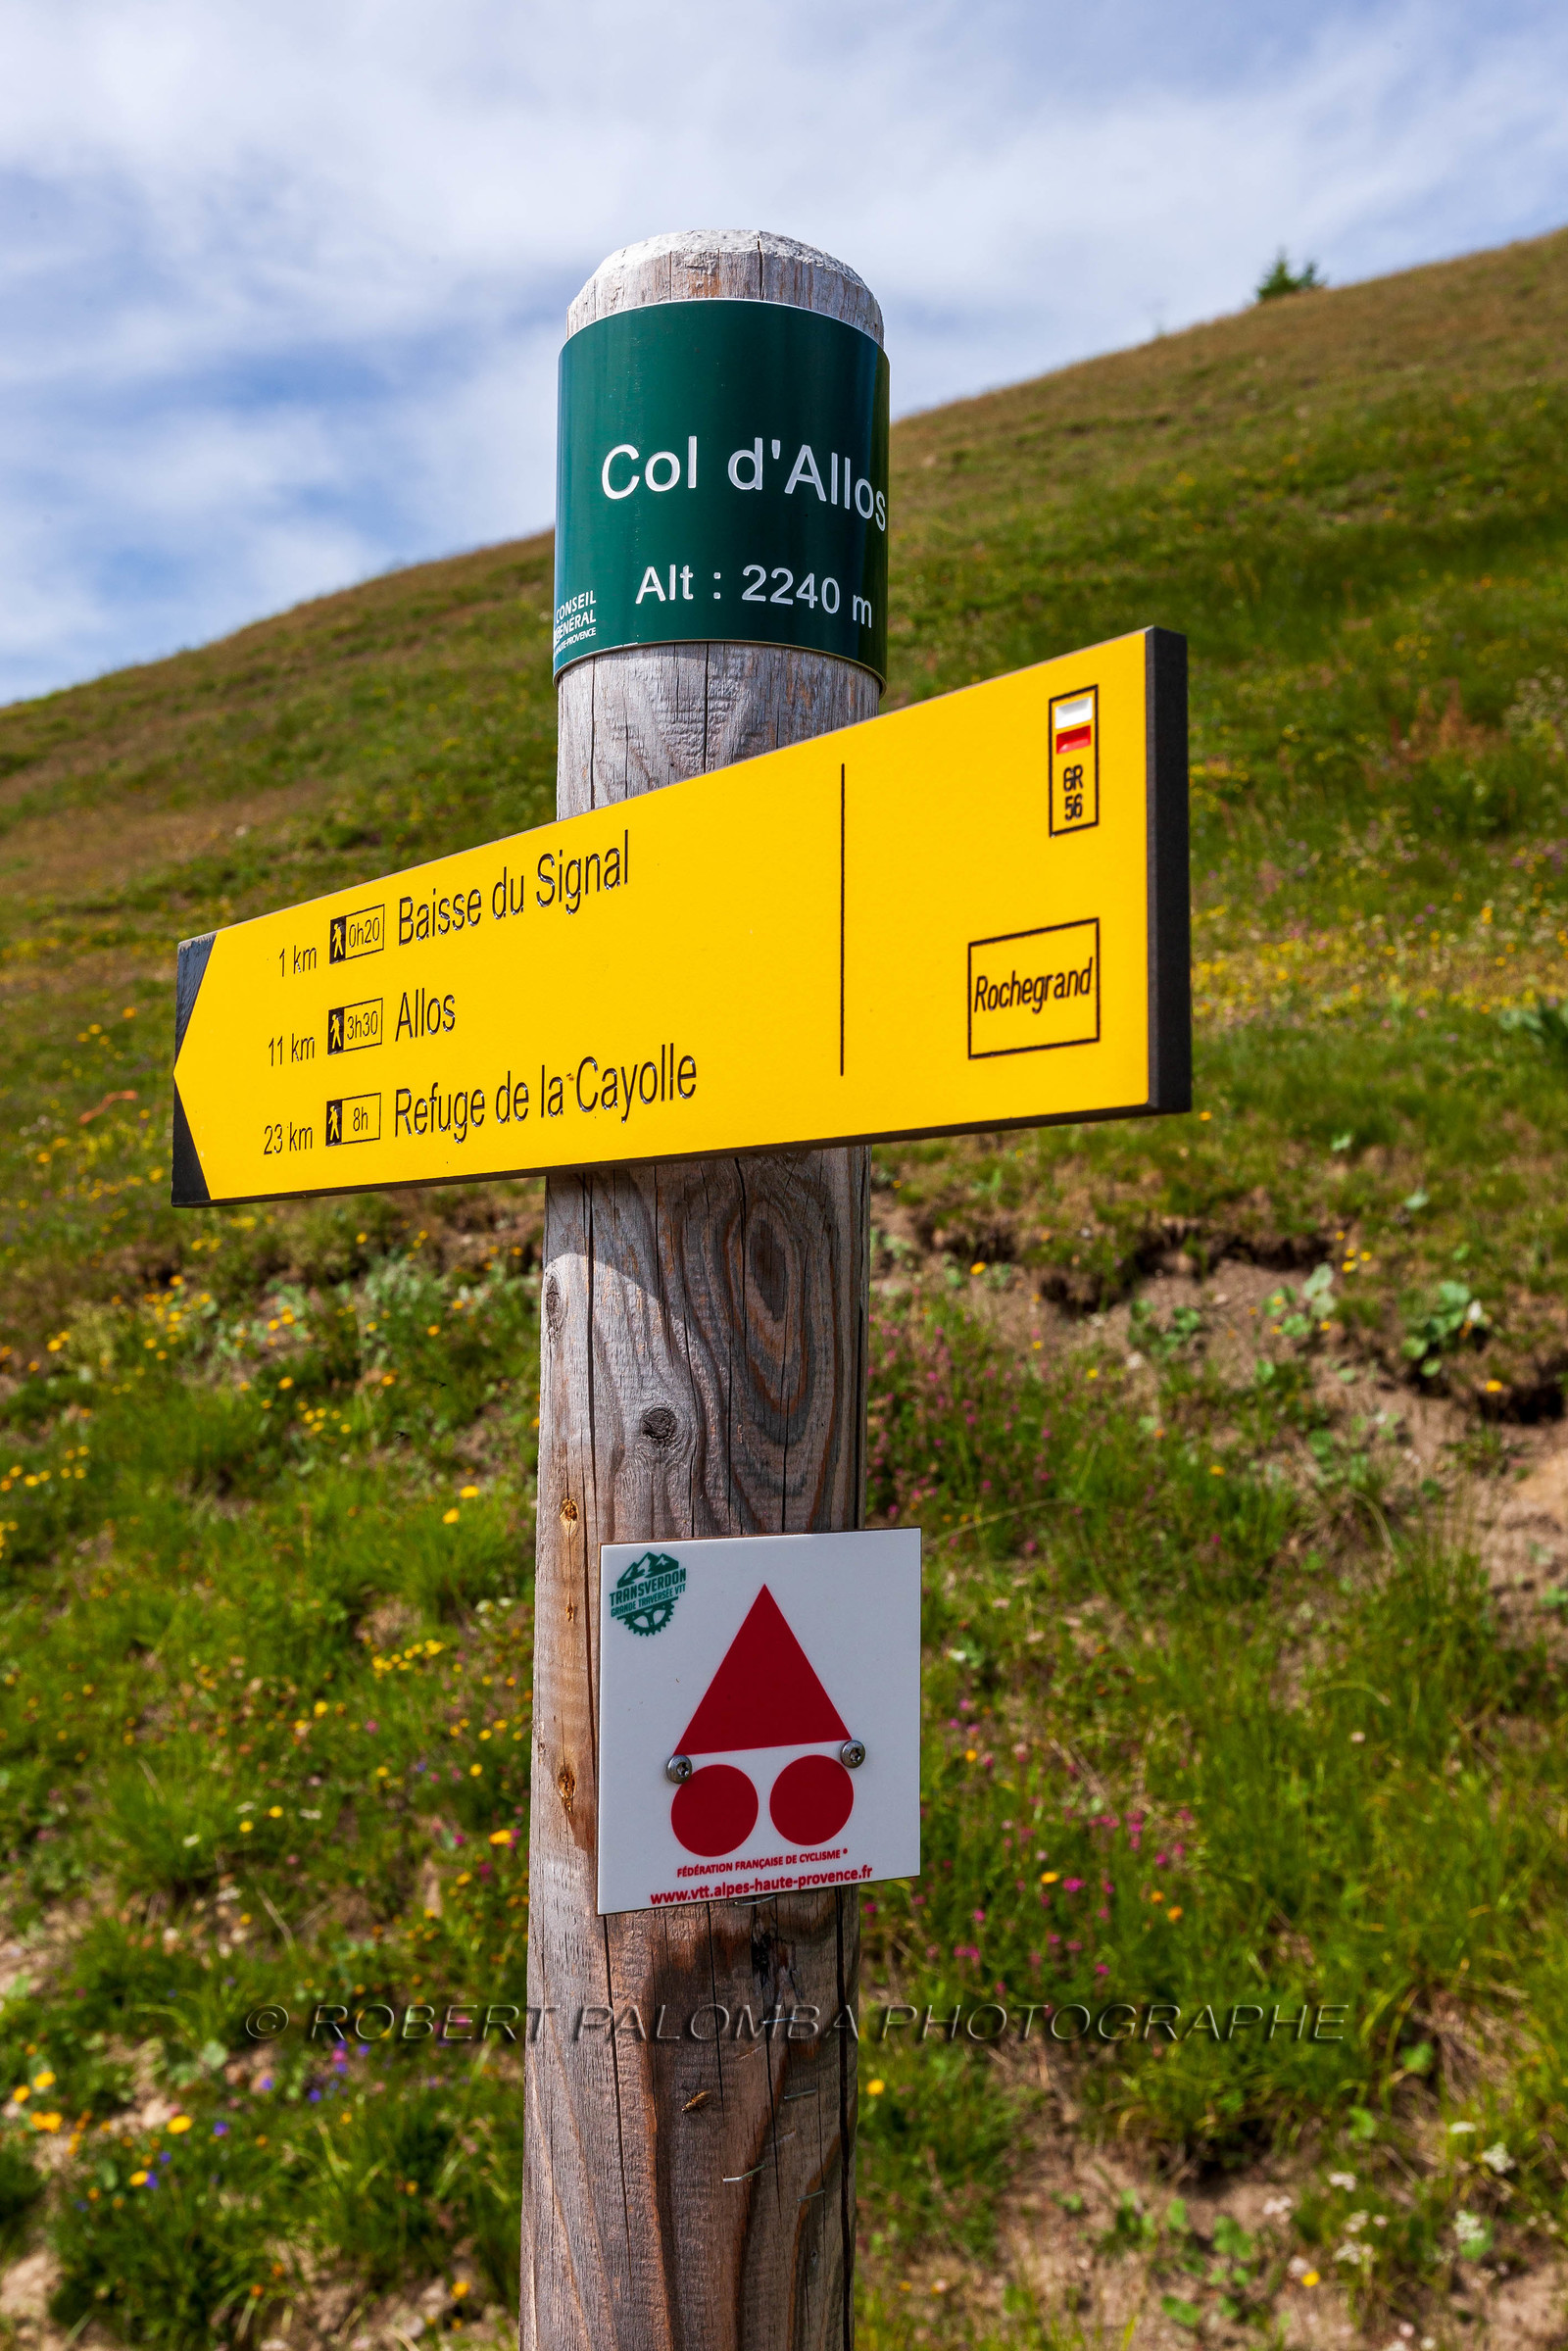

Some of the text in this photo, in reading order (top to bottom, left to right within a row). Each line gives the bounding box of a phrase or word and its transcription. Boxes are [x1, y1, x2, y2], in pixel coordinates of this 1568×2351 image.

[601, 435, 886, 531] Col d'Allos
[556, 590, 597, 624] CONSEIL
[635, 564, 694, 605] Alt
[742, 564, 840, 614] 2240
[852, 594, 872, 628] m
[1063, 764, 1084, 793] GR
[1064, 793, 1083, 821] 56
[278, 829, 628, 978] 1 km 0h20 Baisse du Signal
[974, 955, 1093, 1014] Rochegrand
[269, 987, 456, 1067] 11 km 3h30 Allos
[264, 1042, 698, 1155] 23 km 8h Refuge de la Cayolle
[610, 1568, 686, 1606] TRANSVERDON
[611, 1583, 686, 1617] GRANDE TRAVERSÉE VTT
[676, 1849, 841, 1878] FÉDÉRATION FRANÇAISE DE CYCLISME
[650, 1864, 873, 1905] www.vtt.alpes-haute-provence.fr
